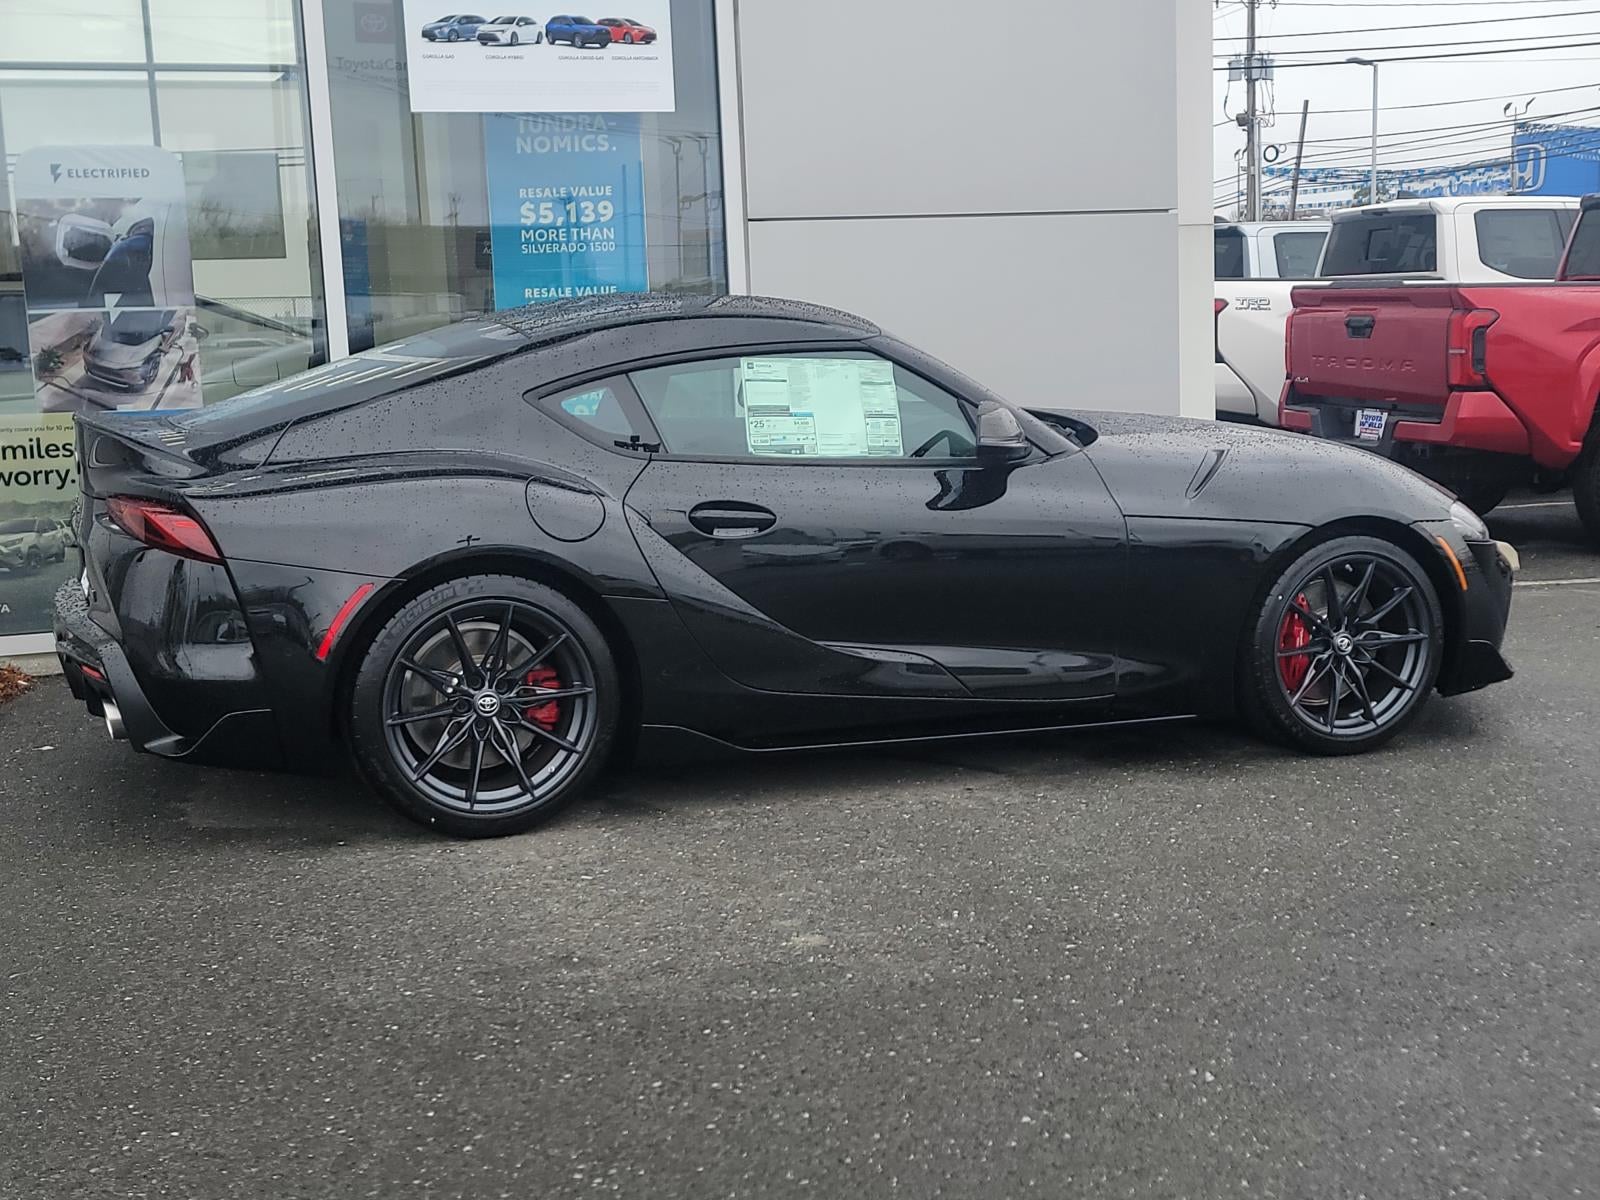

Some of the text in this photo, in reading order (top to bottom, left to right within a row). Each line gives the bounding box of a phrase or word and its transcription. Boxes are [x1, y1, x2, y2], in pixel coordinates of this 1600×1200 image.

[516, 134, 617, 154] NOMICS.
[67, 168, 150, 178] ELECTRIFIED
[519, 185, 613, 198] RESALE VALUE
[520, 200, 614, 226] $5,139
[521, 227, 615, 242] MORE THAN
[521, 241, 616, 254] SILVERADO 1500
[524, 287, 573, 299] RESALE
[1235, 297, 1271, 306] TRD
[1311, 354, 1417, 373] TACOMA
[1360, 420, 1383, 428] WORLD
[1361, 414, 1383, 422] TOYOTA
[1, 436, 75, 461] miles
